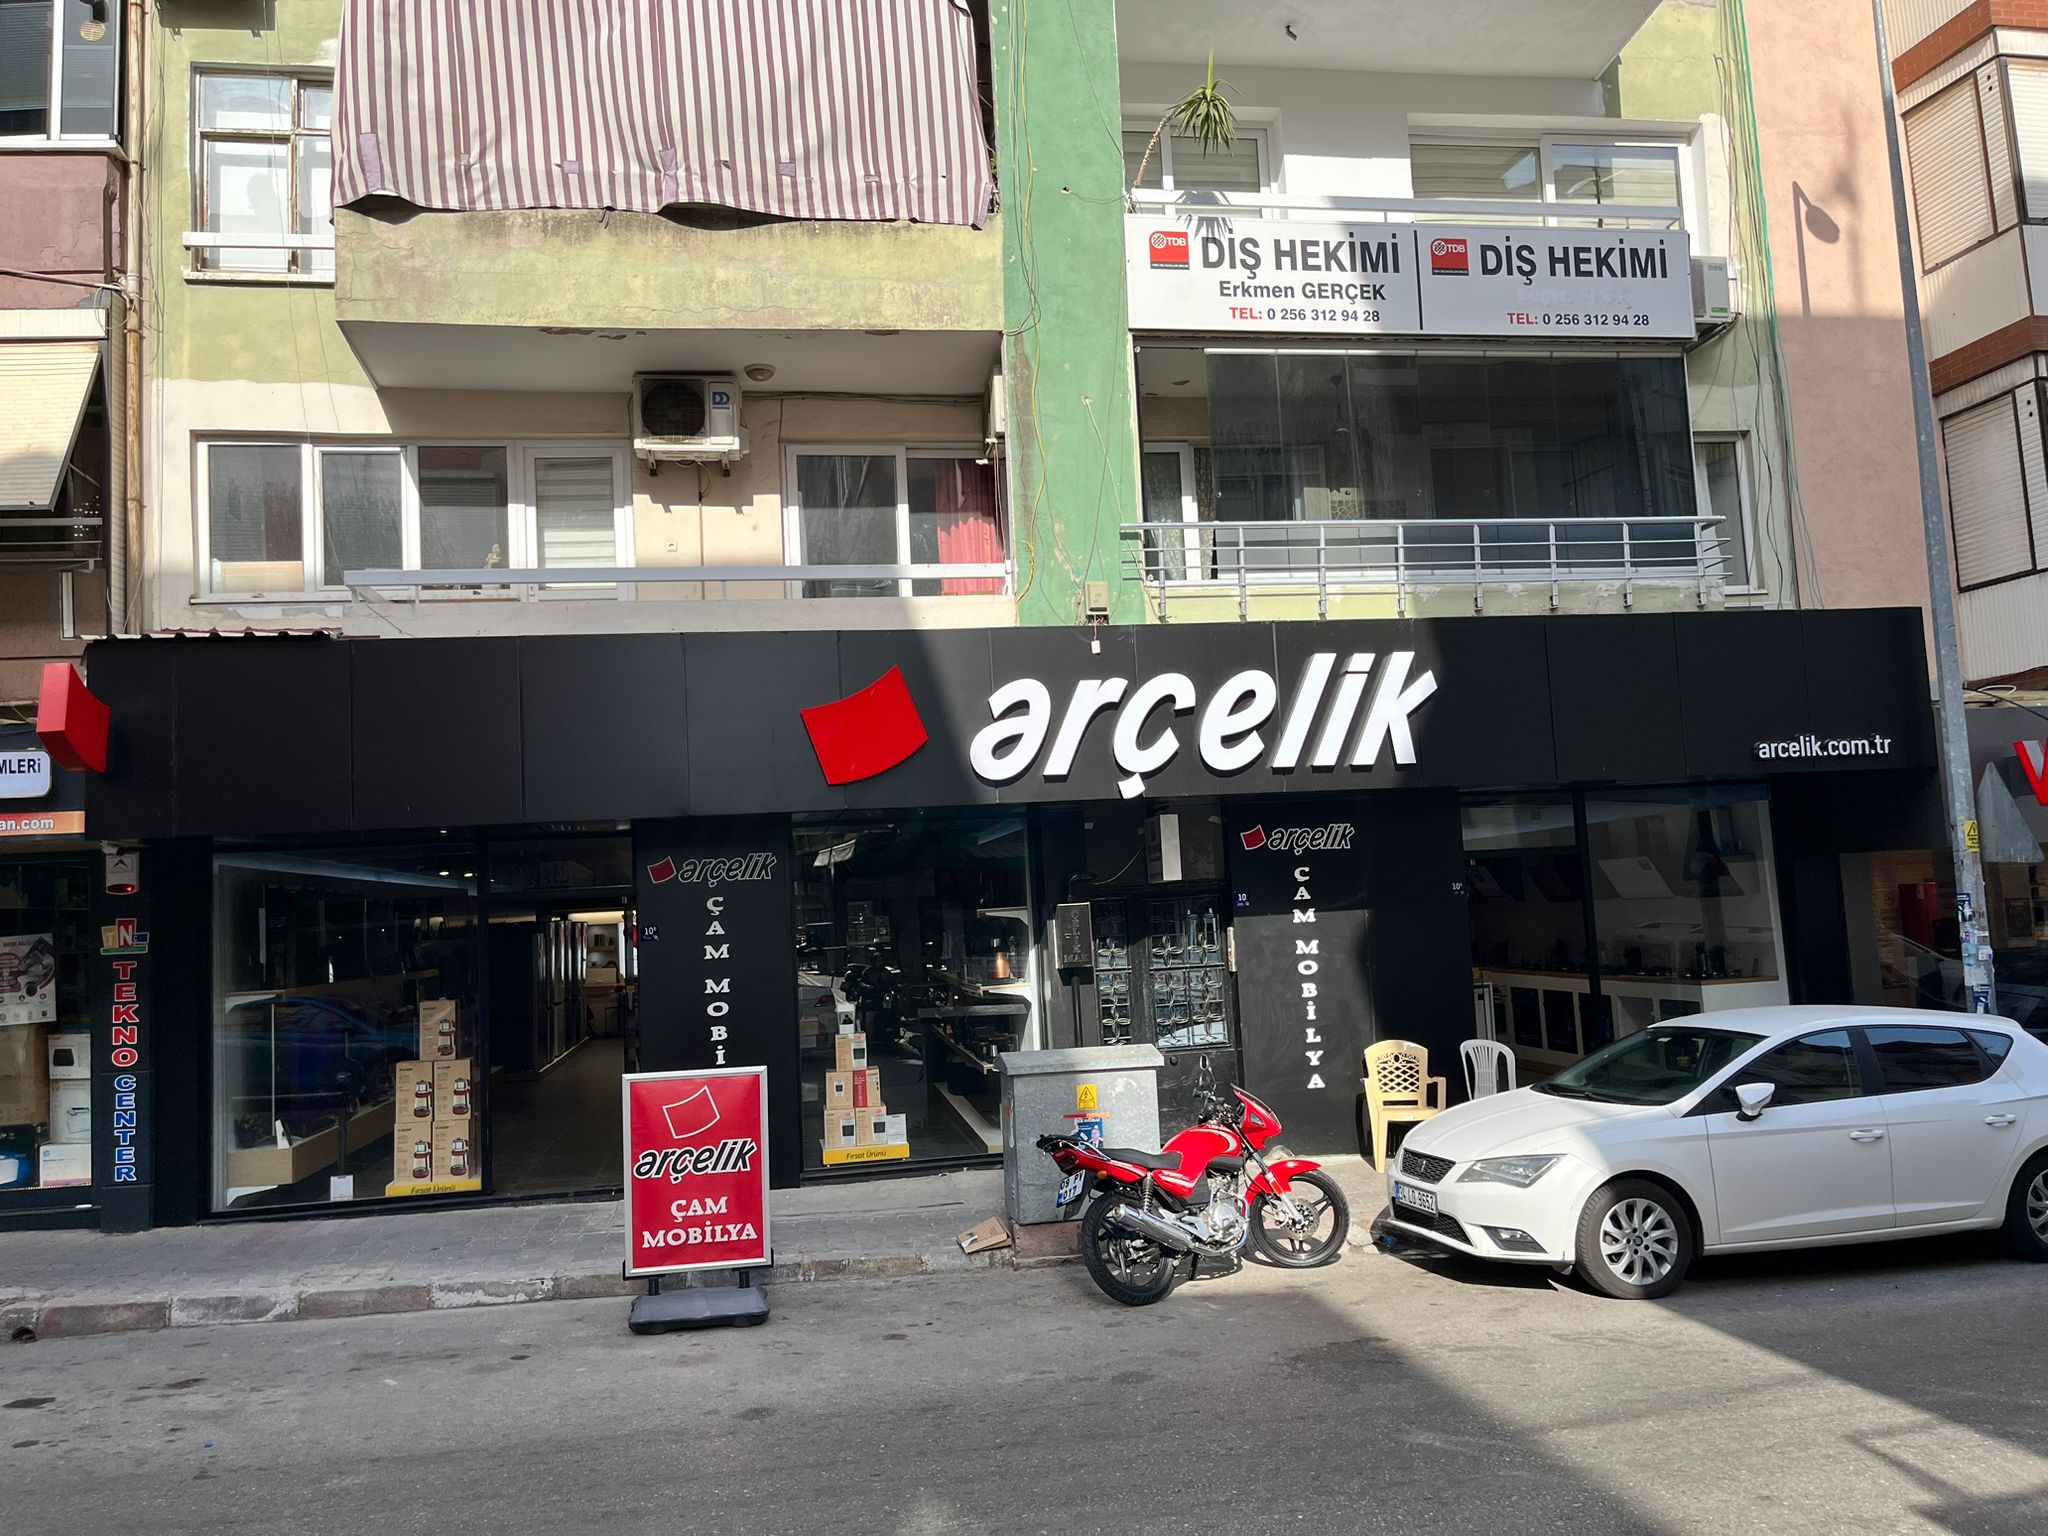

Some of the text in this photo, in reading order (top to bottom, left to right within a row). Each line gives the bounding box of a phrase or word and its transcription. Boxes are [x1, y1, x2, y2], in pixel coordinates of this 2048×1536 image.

[1166, 237, 1188, 247] TDB
[1201, 227, 1400, 279] DİŞ HEKİMİ
[1446, 243, 1466, 253] TDB
[1480, 235, 1668, 286] DİŞ HEKİMİ
[1219, 280, 1387, 305] Erkmen GERÇEK
[1229, 307, 1380, 322] TEL: 0 256 312 94 28
[1507, 312, 1650, 326] TEL: 0 256 312 94 28
[969, 651, 1438, 800] arçelik
[1758, 734, 1892, 758] arcelik.com.tr
[1267, 823, 1355, 855] arçelik
[678, 852, 777, 887] arçelik
[703, 896, 730, 960] ÇAM
[1292, 866, 1326, 1089] ÇAM MOBİLYA
[111, 961, 139, 1067] TEKNO
[114, 1074, 136, 1182] CENTER
[633, 1137, 758, 1185] arçelik
[671, 1196, 728, 1223] ÇAM
[641, 1220, 758, 1249] MOBİLYA
